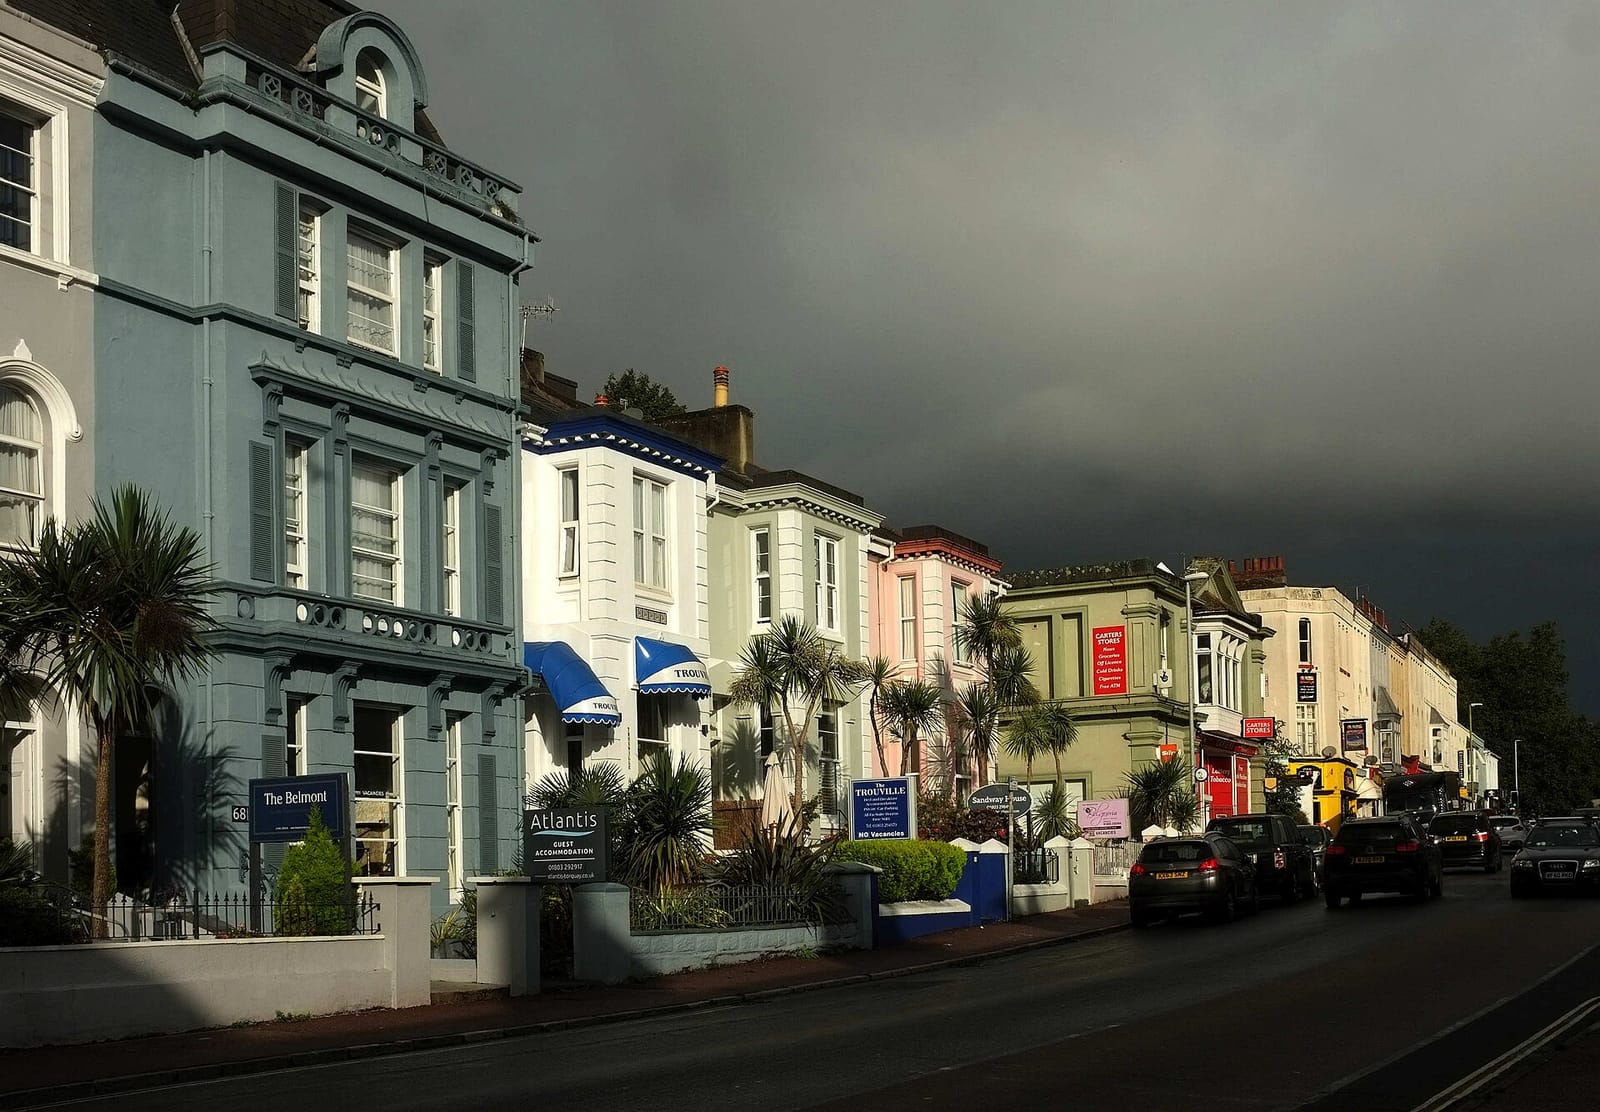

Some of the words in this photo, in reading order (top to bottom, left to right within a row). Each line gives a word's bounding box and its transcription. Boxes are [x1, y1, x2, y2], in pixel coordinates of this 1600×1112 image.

[855, 787, 905, 796] TROUVILLE
[264, 793, 283, 805] The
[285, 790, 327, 804] Belmont
[972, 796, 1004, 804] Sandway
[232, 808, 246, 820] 68
[530, 811, 597, 829] Atlantis
[535, 848, 594, 856] ACCOMMODATION
